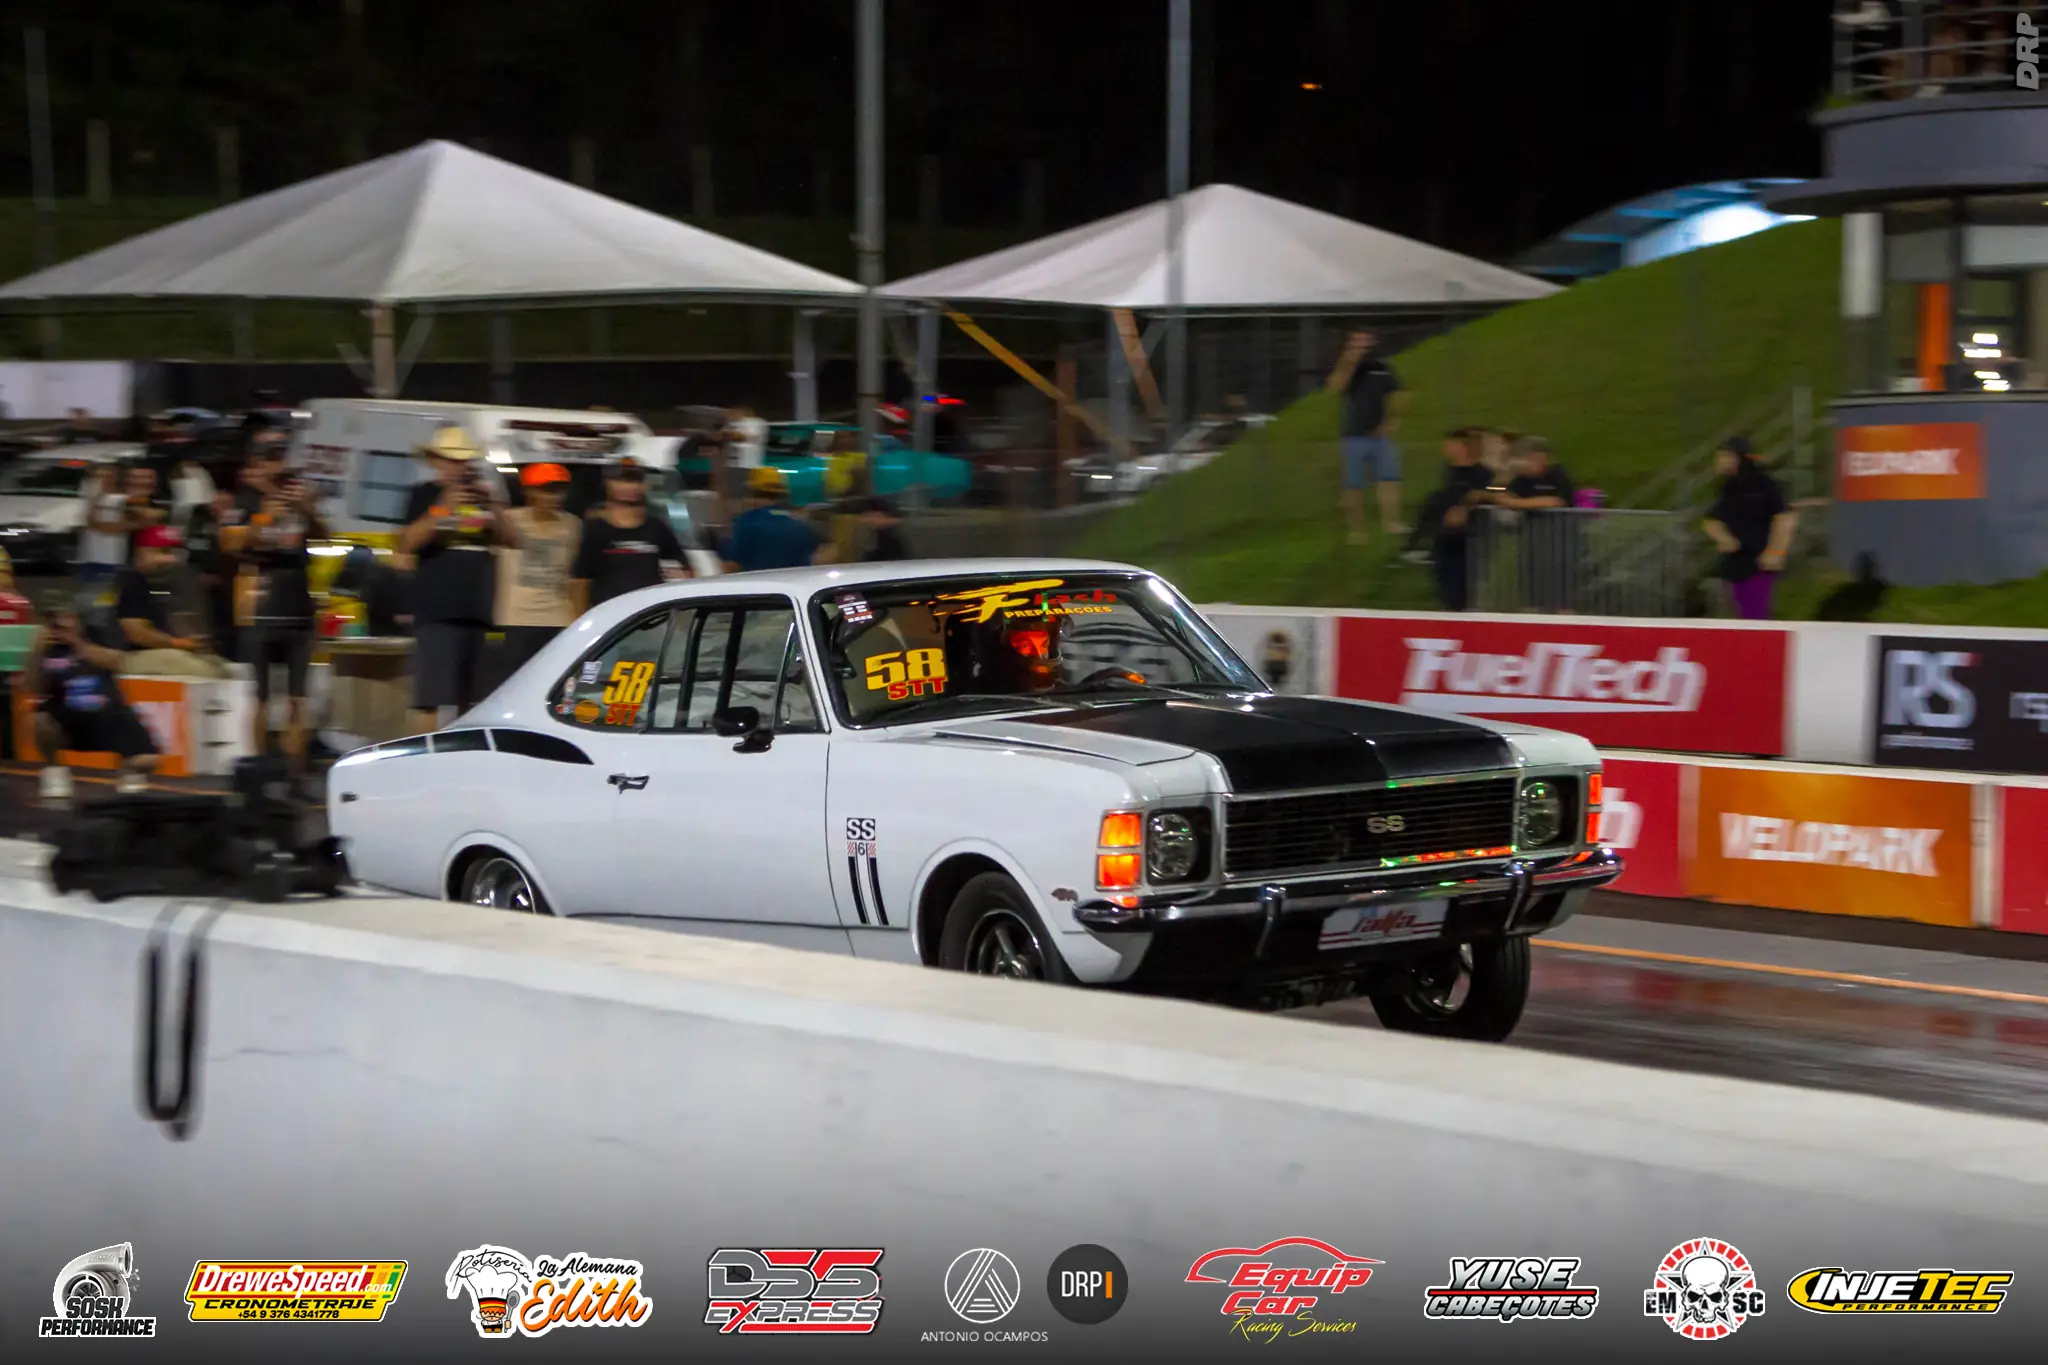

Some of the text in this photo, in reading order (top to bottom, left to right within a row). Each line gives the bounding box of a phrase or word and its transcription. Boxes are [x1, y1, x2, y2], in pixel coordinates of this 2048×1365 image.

[602, 661, 656, 705] 58
[865, 648, 946, 690] 58
[887, 677, 948, 700] STT
[1401, 637, 1707, 712] FuelTech
[1883, 650, 1983, 728] RS
[605, 703, 642, 726] STT
[847, 818, 876, 840] SS
[1367, 814, 1406, 833] SS
[1719, 813, 1944, 877] VELOPARK
